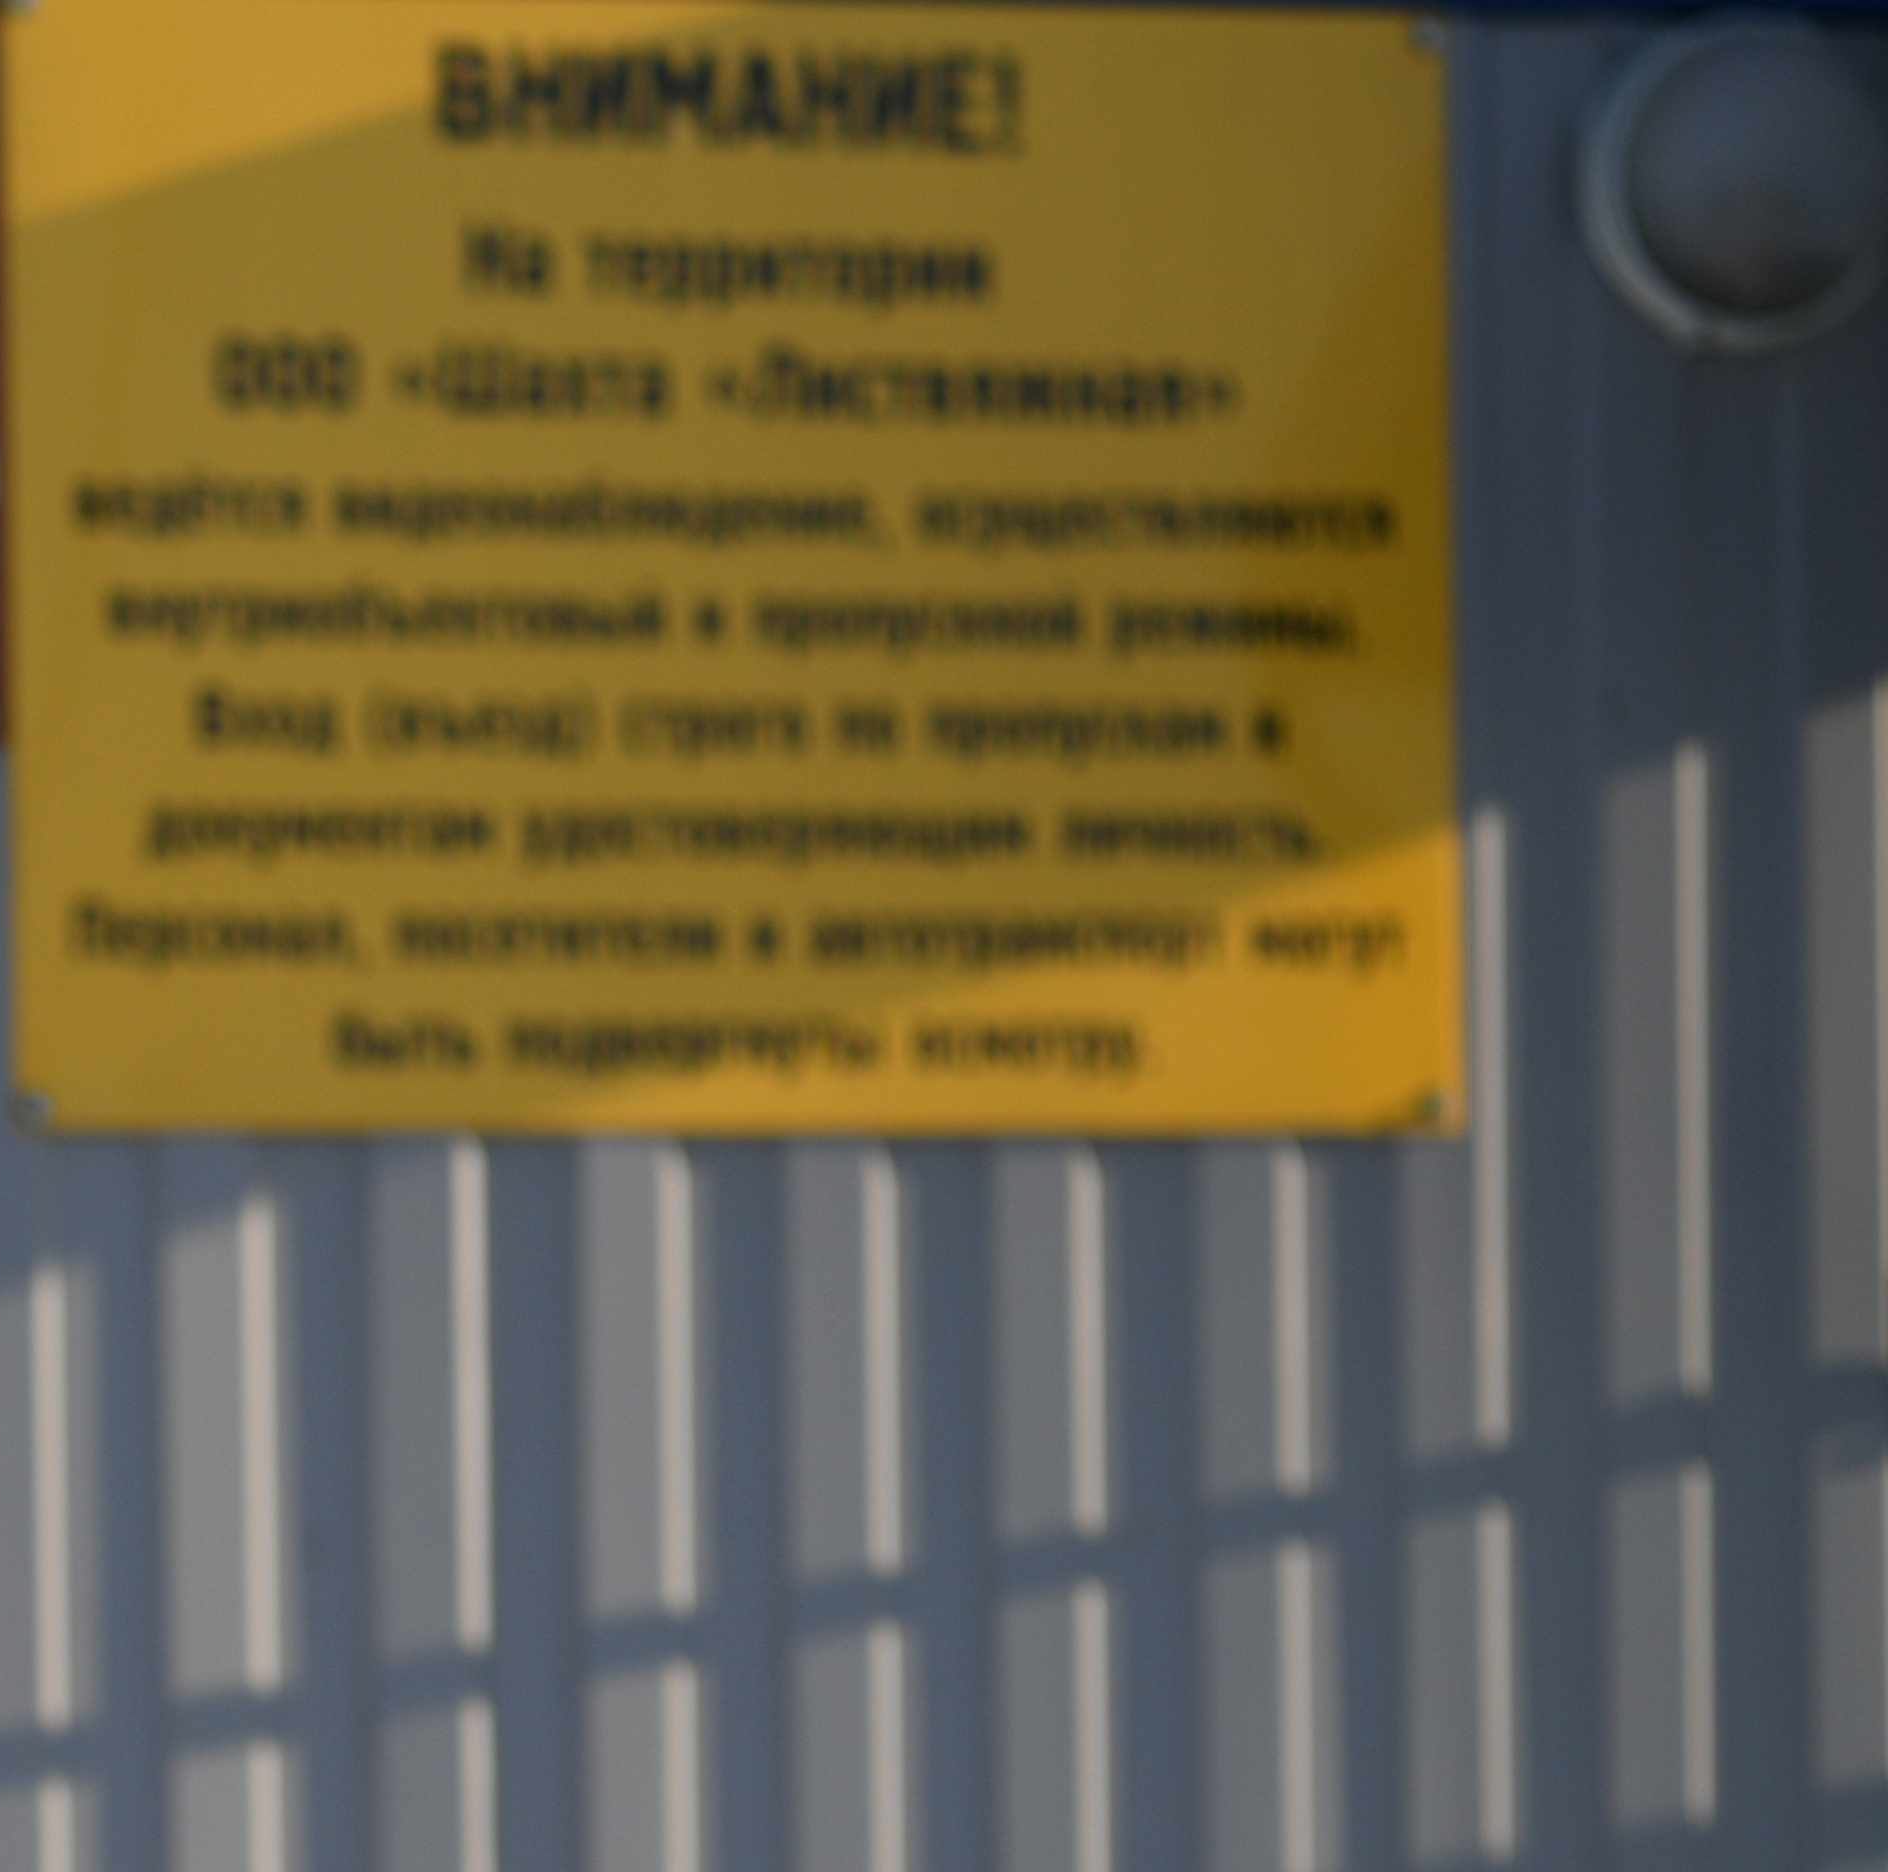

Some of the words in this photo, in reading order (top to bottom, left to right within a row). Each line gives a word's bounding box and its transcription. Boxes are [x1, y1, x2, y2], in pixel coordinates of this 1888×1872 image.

[431, 44, 1019, 152] ВНИМАНИЕ!
[462, 225, 555, 294] На
[583, 232, 996, 310] территории
[212, 335, 362, 413] ООО
[393, 343, 674, 421] «Шахта
[707, 345, 1235, 426] «Листвяжная»
[831, 700, 904, 754] по
